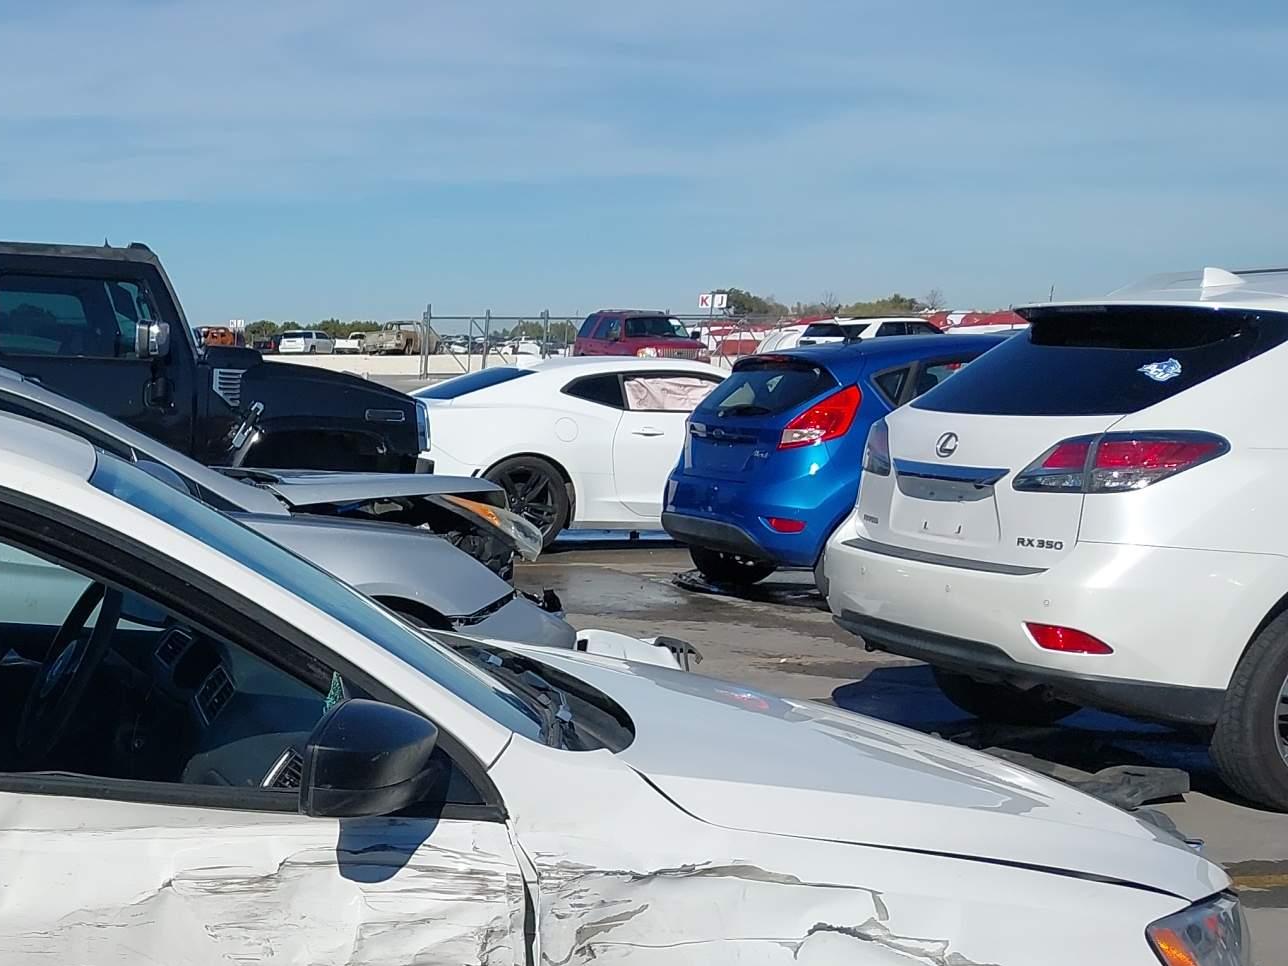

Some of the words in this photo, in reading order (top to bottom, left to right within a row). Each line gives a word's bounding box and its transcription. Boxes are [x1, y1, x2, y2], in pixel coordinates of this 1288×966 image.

[701, 295, 709, 307] K
[1016, 537, 1034, 548] RX
[1035, 539, 1064, 550] 350
